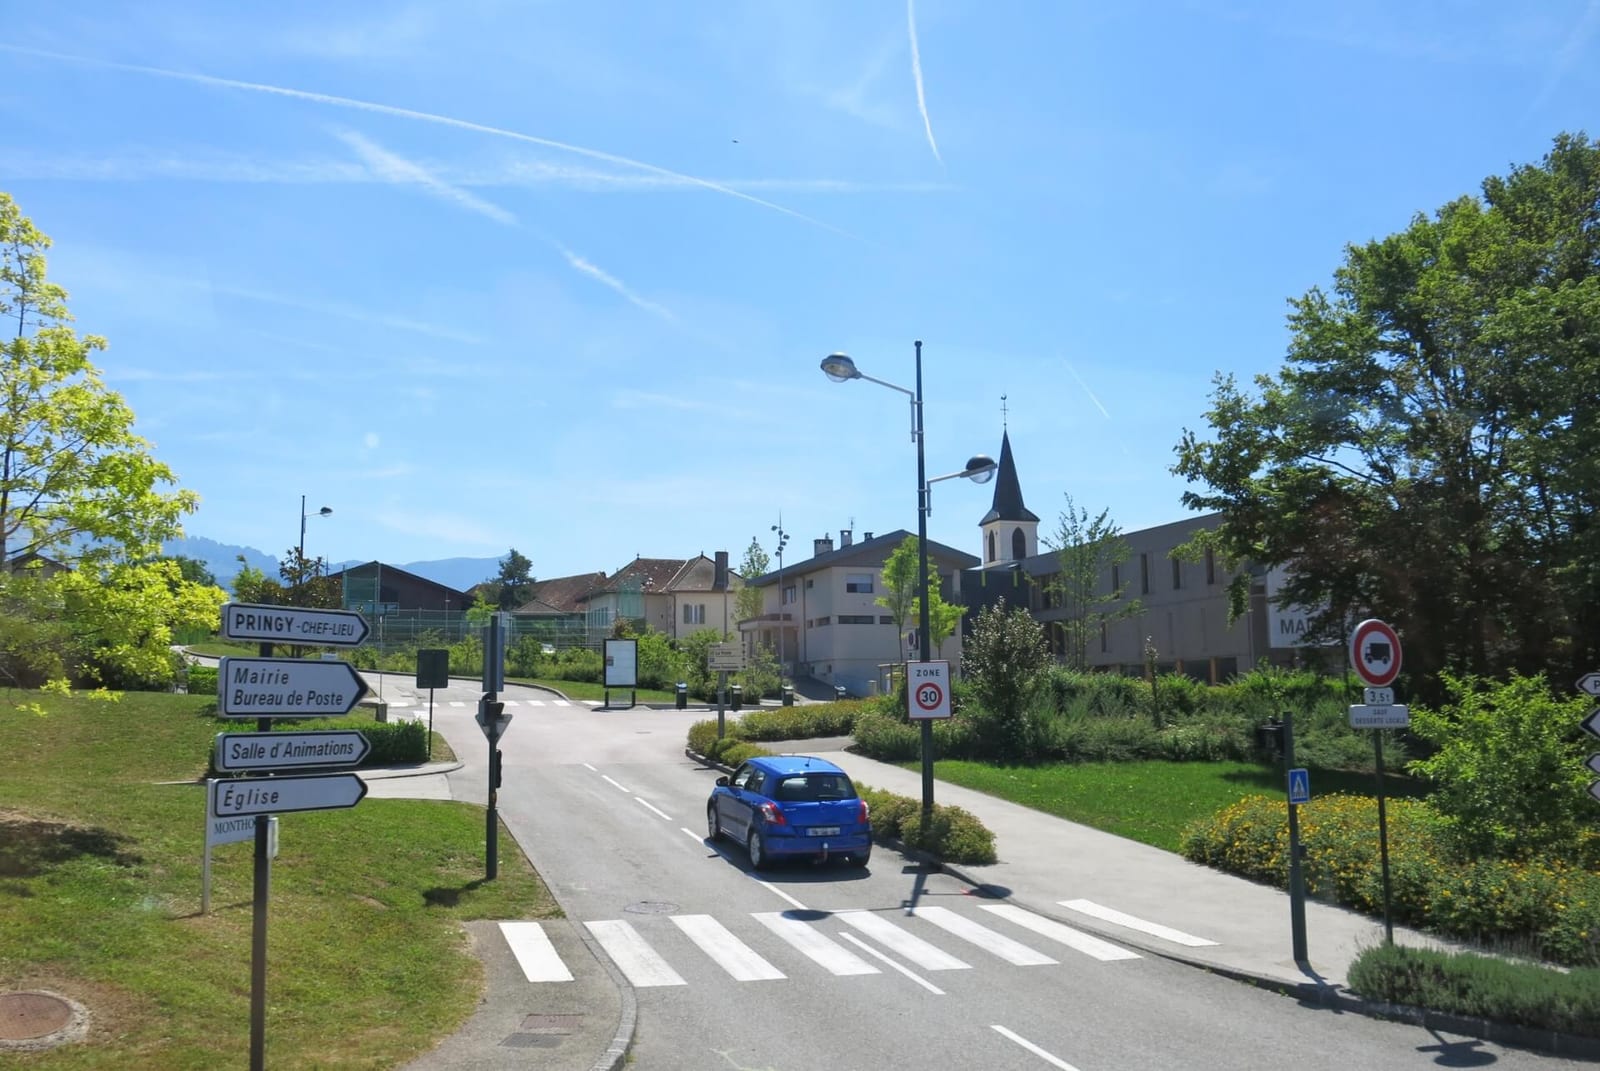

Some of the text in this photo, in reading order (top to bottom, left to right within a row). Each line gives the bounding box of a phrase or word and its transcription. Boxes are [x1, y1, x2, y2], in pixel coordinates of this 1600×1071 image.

[235, 613, 294, 633] PRINGY
[233, 667, 289, 685] Mairie
[916, 669, 940, 677] ZONE
[233, 689, 343, 706] Bureau de Poste
[921, 690, 937, 702] 30
[231, 742, 265, 760] Salle
[223, 784, 279, 811] Église
[214, 817, 256, 834] MONTHO
